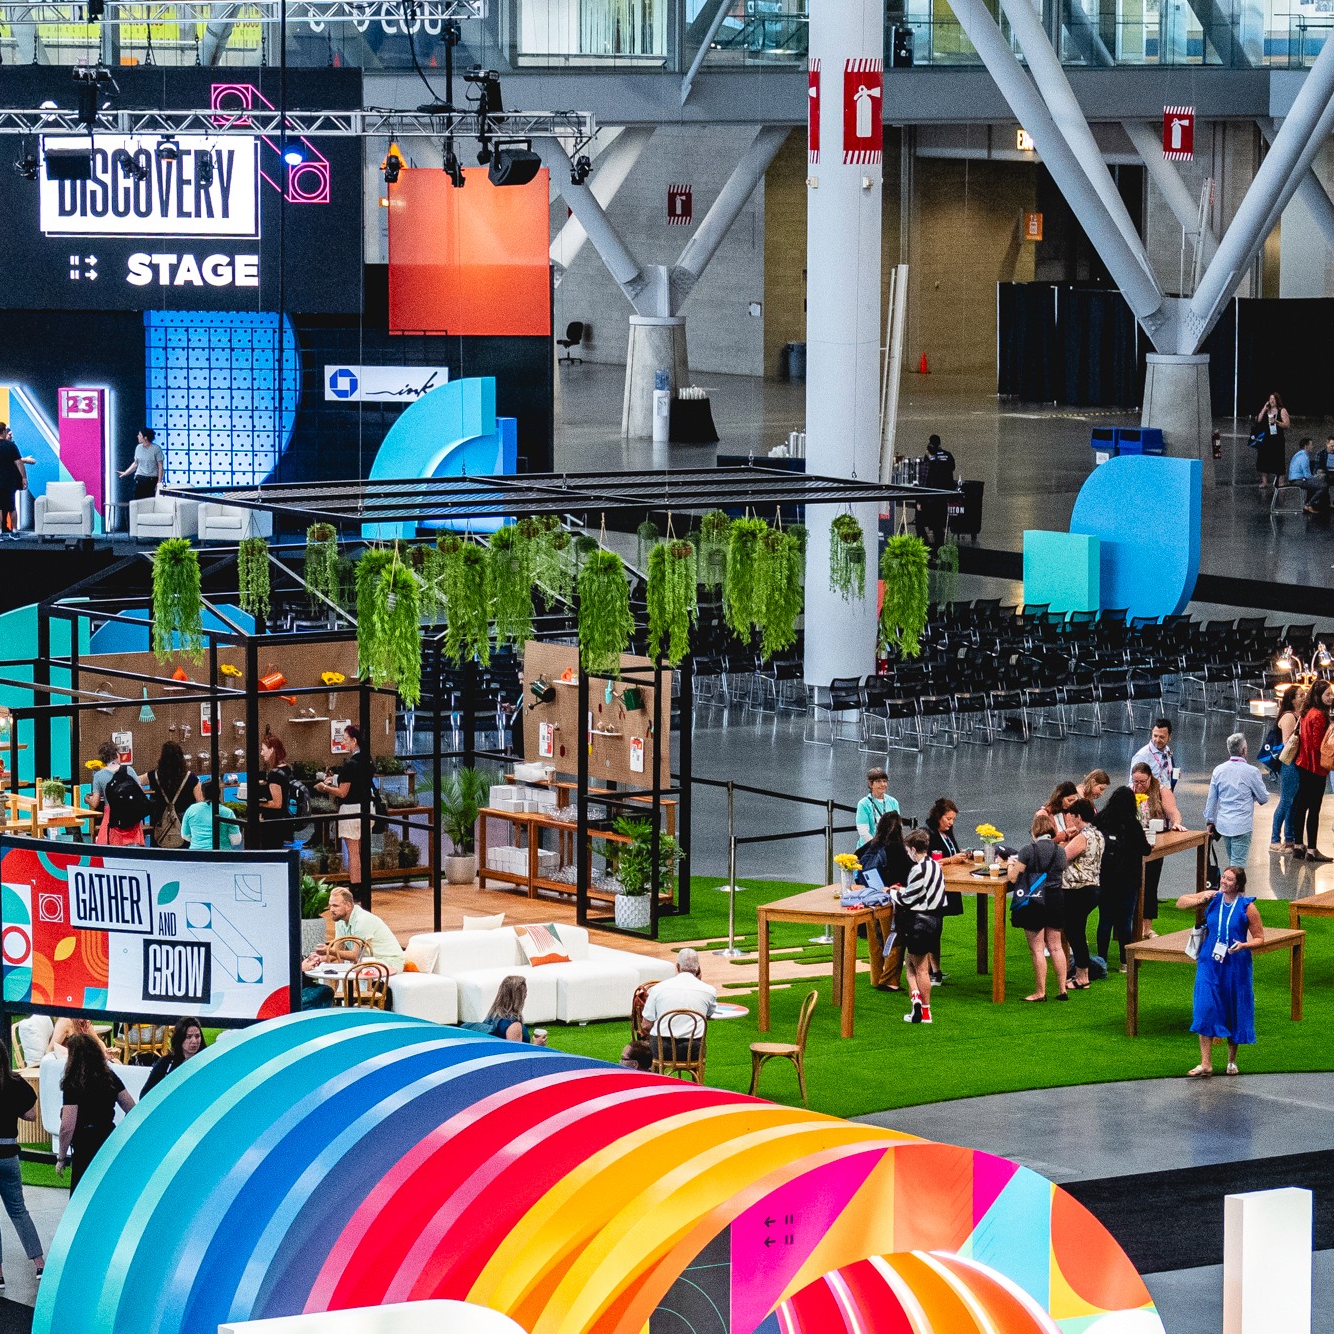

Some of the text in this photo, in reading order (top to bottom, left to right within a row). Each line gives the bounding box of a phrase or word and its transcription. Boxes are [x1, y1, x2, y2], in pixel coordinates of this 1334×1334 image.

[126, 252, 259, 287] STAGE
[74, 871, 143, 925] GATHER
[158, 911, 177, 937] AND
[148, 943, 206, 998] GROW
